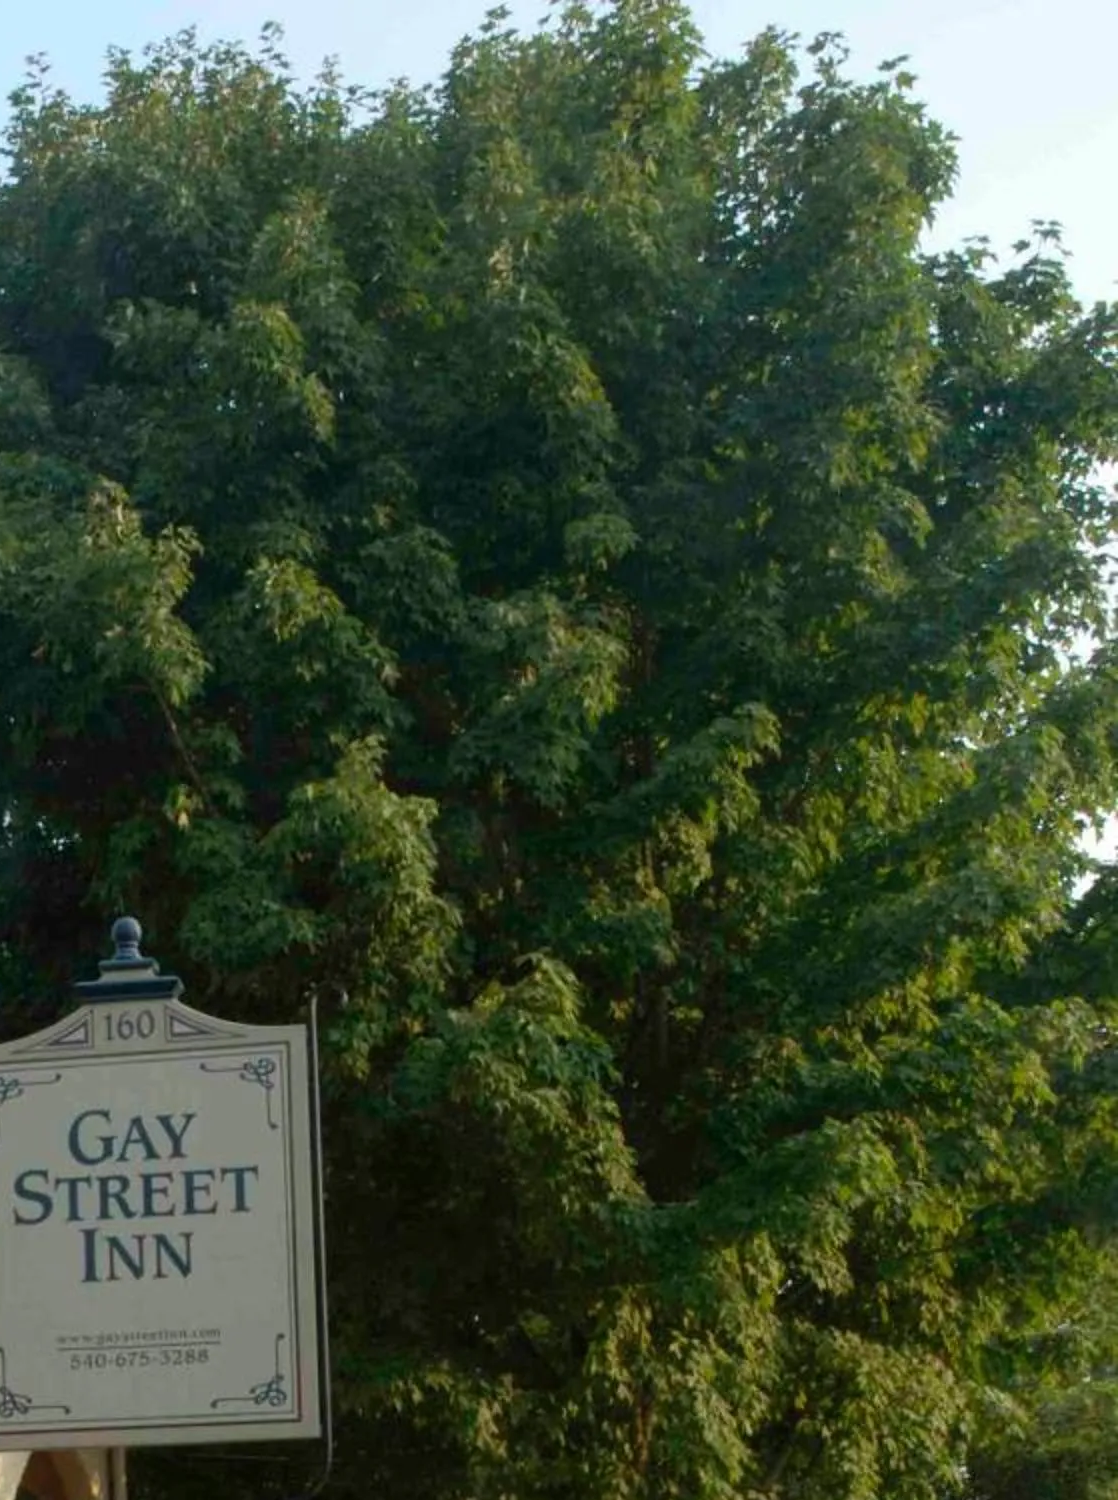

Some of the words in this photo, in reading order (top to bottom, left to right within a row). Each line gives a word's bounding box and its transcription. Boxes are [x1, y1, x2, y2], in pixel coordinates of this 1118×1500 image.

[103, 1009, 156, 1041] 160
[68, 1109, 197, 1165] GAY
[13, 1166, 259, 1226] STREET
[79, 1228, 194, 1283] INN
[70, 1349, 210, 1370] 540-675-3288
